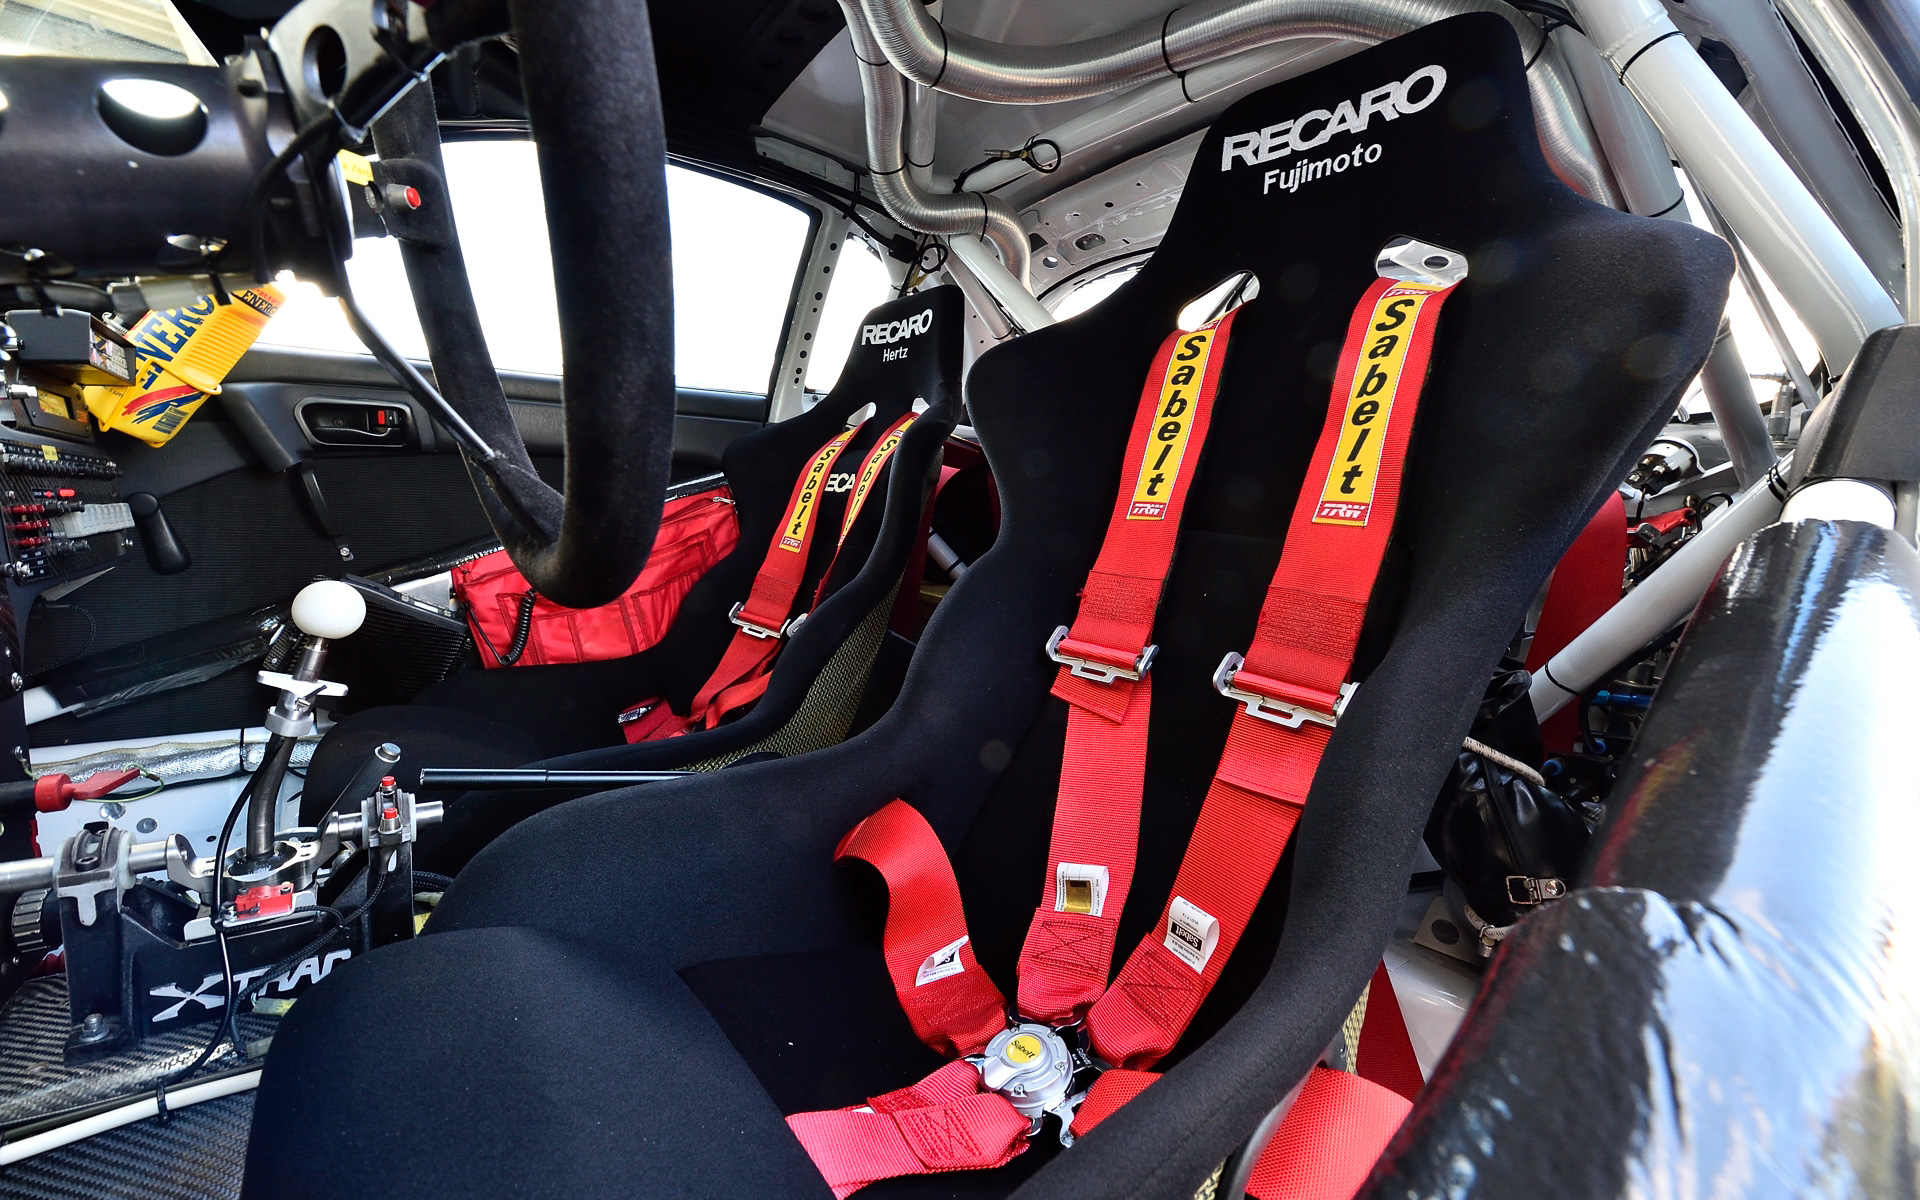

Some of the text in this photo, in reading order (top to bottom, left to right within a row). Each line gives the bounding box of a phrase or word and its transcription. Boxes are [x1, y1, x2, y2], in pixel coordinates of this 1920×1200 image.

[1221, 64, 1448, 172] RECARO
[1263, 143, 1382, 195] Fujimoto
[861, 308, 933, 346] RECARO
[882, 346, 909, 363] Hertz
[1146, 335, 1207, 496] Sabelt
[1339, 298, 1416, 495] Sabelt
[791, 448, 836, 535] Sabelt
[1133, 503, 1165, 516] TRW
[1321, 503, 1367, 518] TRW
[1175, 925, 1199, 948] Sabelt
[1011, 1040, 1036, 1059] Sabelt
